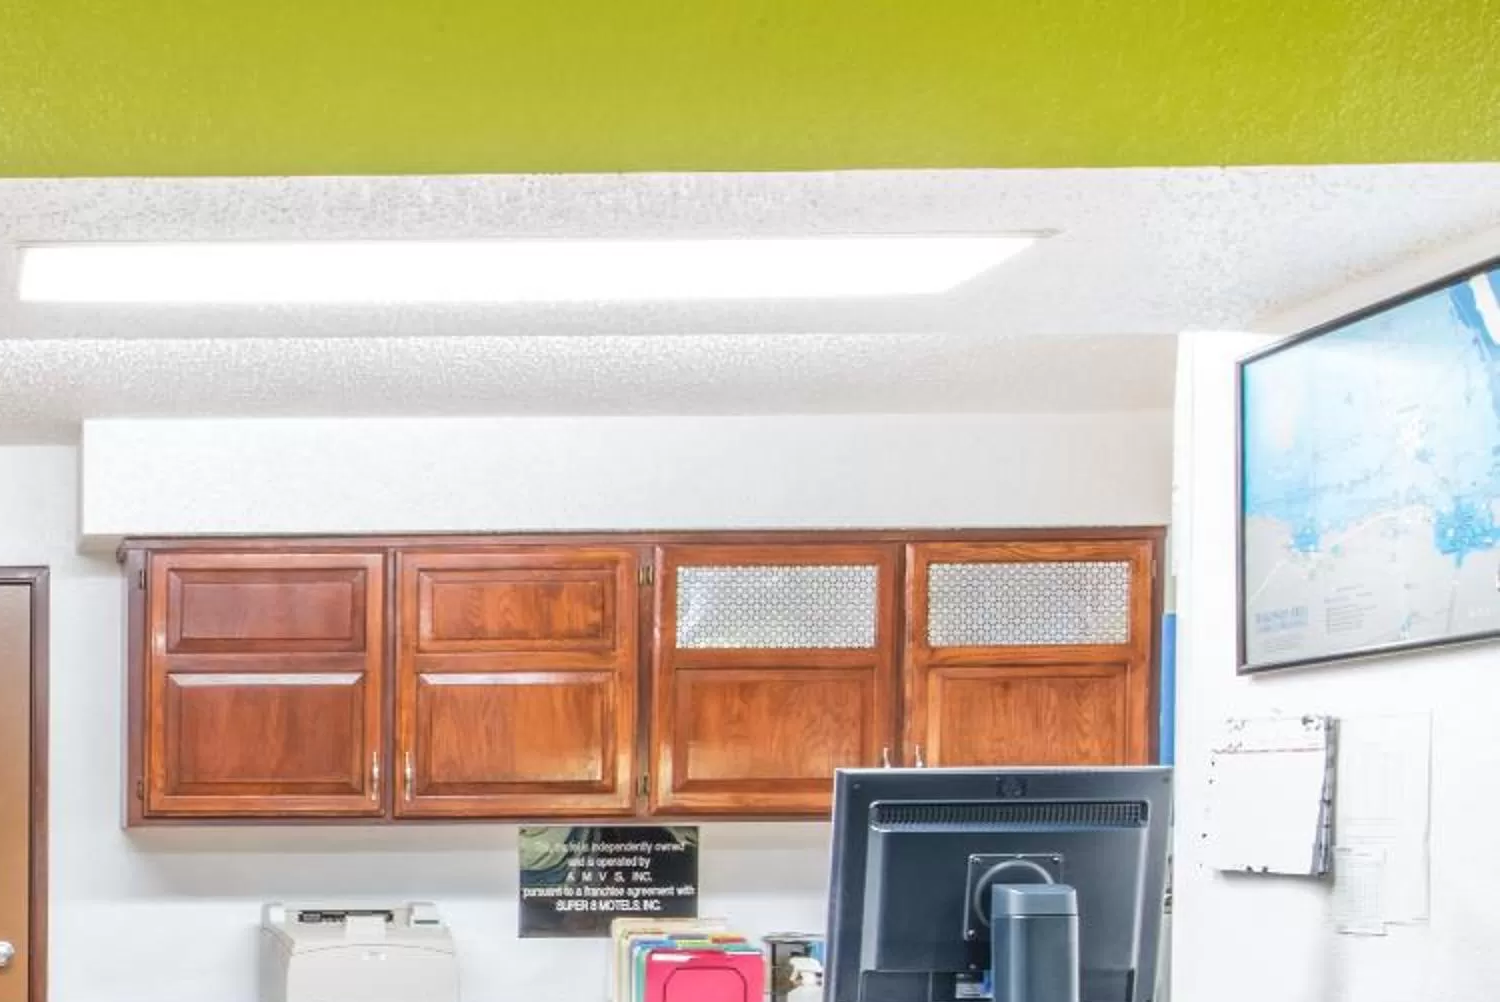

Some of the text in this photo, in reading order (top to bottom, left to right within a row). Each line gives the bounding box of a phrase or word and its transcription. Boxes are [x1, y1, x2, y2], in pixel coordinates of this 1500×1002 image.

[596, 856, 636, 868] operated
[638, 856, 650, 869] by
[523, 886, 695, 899] pursuant to a franchise agreement with
[556, 900, 588, 911] SUPER
